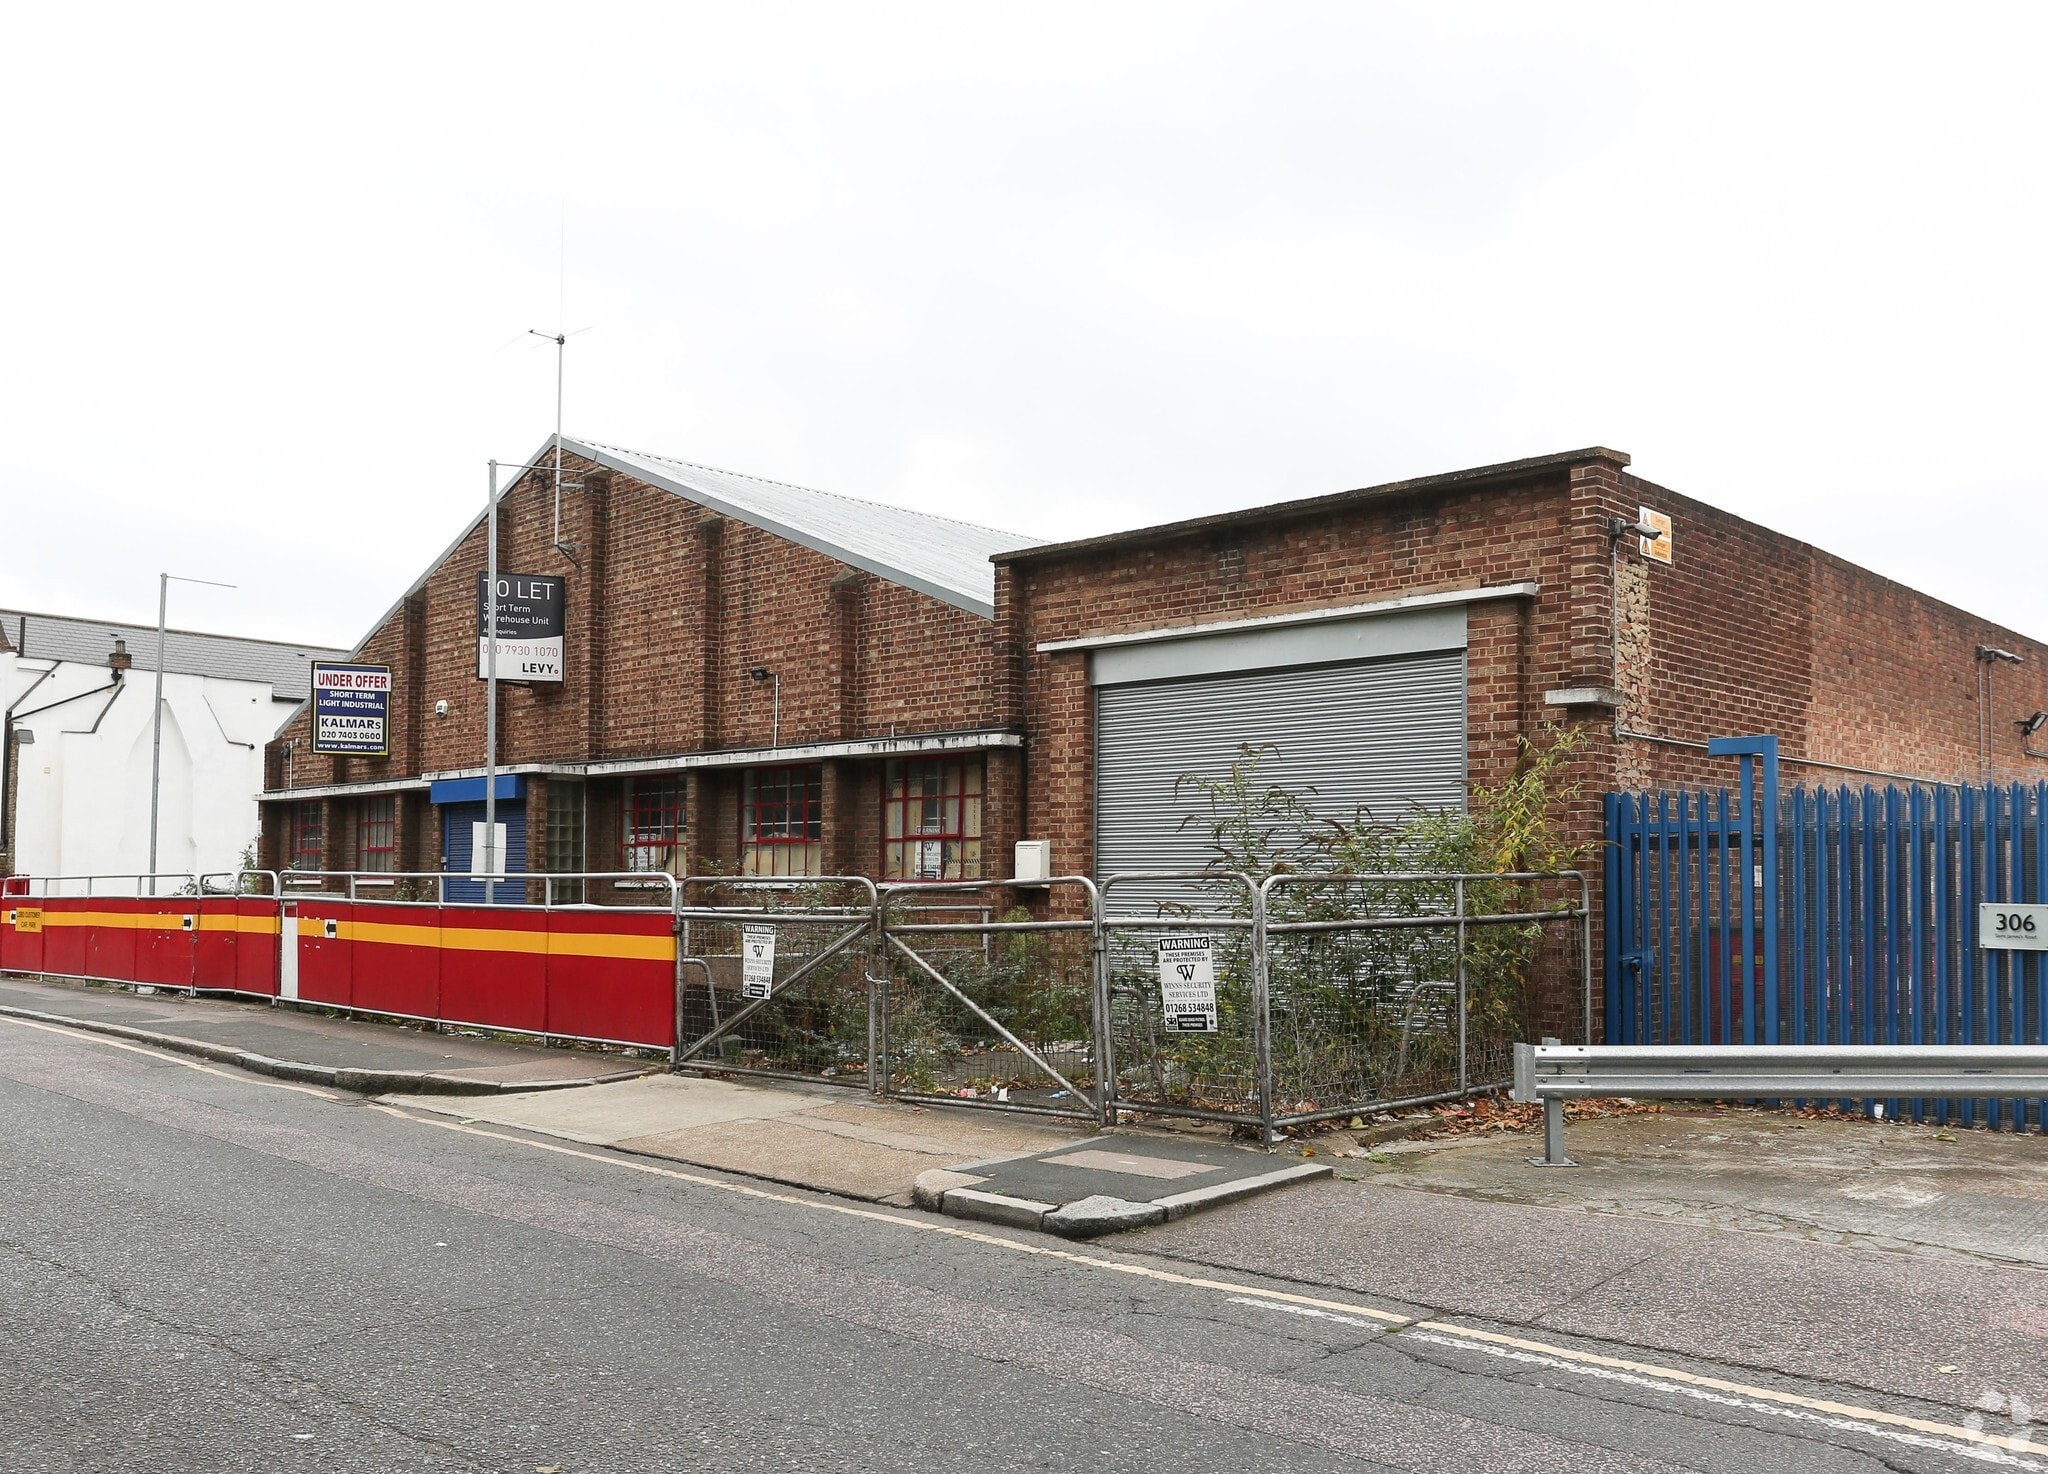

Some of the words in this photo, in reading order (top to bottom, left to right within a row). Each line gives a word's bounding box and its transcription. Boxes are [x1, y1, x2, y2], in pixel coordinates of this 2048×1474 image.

[517, 580, 554, 600] LET
[483, 602, 506, 611] Sort
[509, 604, 530, 613] Term
[483, 614, 530, 624] Wrehouse
[532, 616, 549, 625] Unit
[483, 644, 502, 654] 00
[505, 645, 530, 656] 7930
[535, 647, 558, 657] 1070
[318, 673, 352, 687] UNDER
[355, 674, 387, 688] OFFER
[342, 701, 384, 709] INDUSTRIAL
[1996, 913, 2036, 931] 306
[745, 925, 774, 934] WARNING
[1162, 938, 1208, 950] WARNING
[1166, 1003, 1187, 1012] 01268
[1188, 1002, 1214, 1012] 534848
